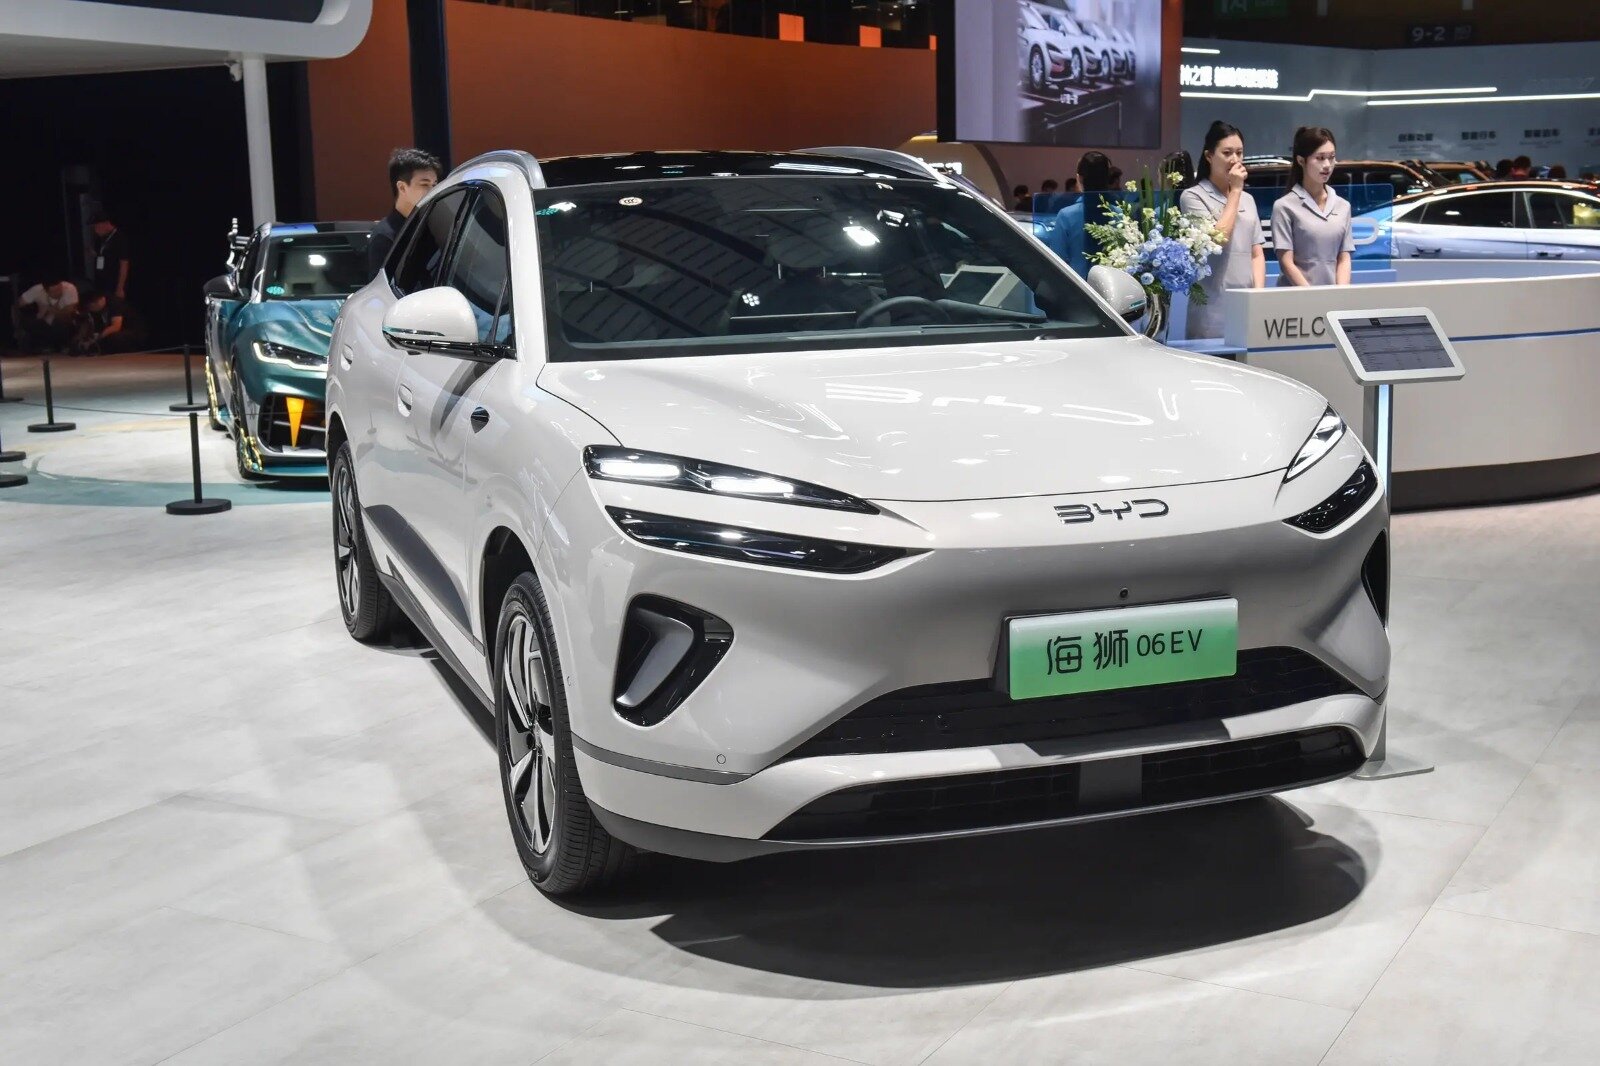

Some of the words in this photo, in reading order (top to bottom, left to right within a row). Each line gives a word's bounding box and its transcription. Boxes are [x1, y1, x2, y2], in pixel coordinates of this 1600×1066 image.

[1264, 316, 1326, 339] WELC
[1054, 498, 1169, 524] BYD
[1047, 629, 1129, 675] 海狮
[1136, 629, 1203, 657] 06EV
